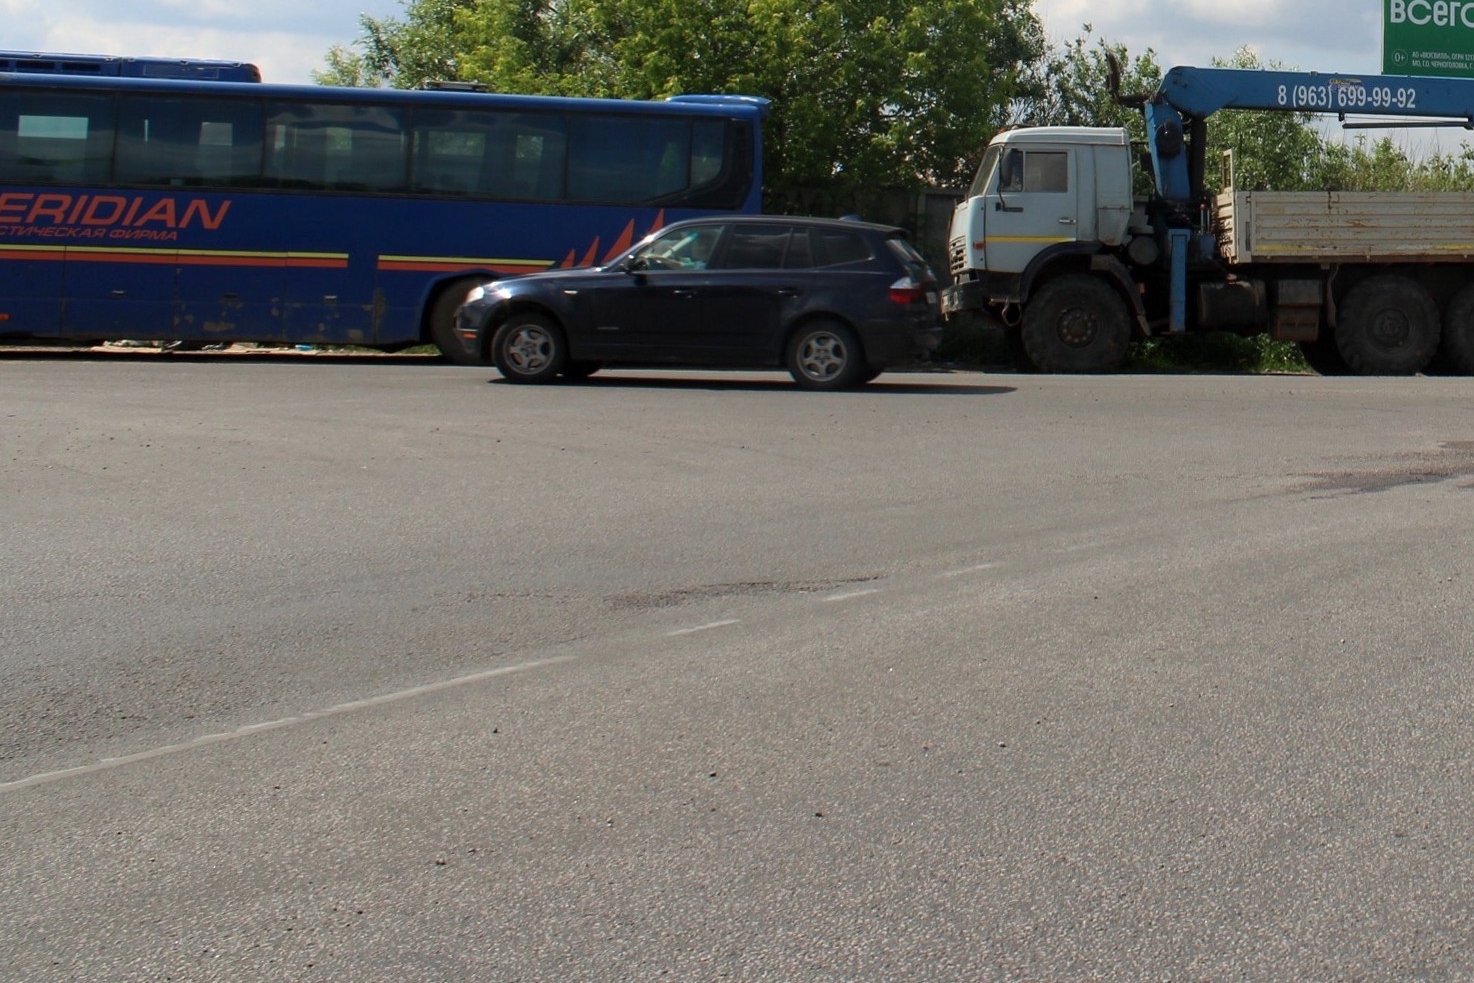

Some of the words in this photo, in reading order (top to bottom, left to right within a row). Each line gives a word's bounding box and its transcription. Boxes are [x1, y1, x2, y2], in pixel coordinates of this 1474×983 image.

[1278, 84, 1287, 105] 8
[1292, 85, 1333, 108] (963)
[1337, 86, 1416, 108] 699-99-92
[0, 192, 232, 230] ERIDIAN
[109, 228, 178, 241] ФИРМА
